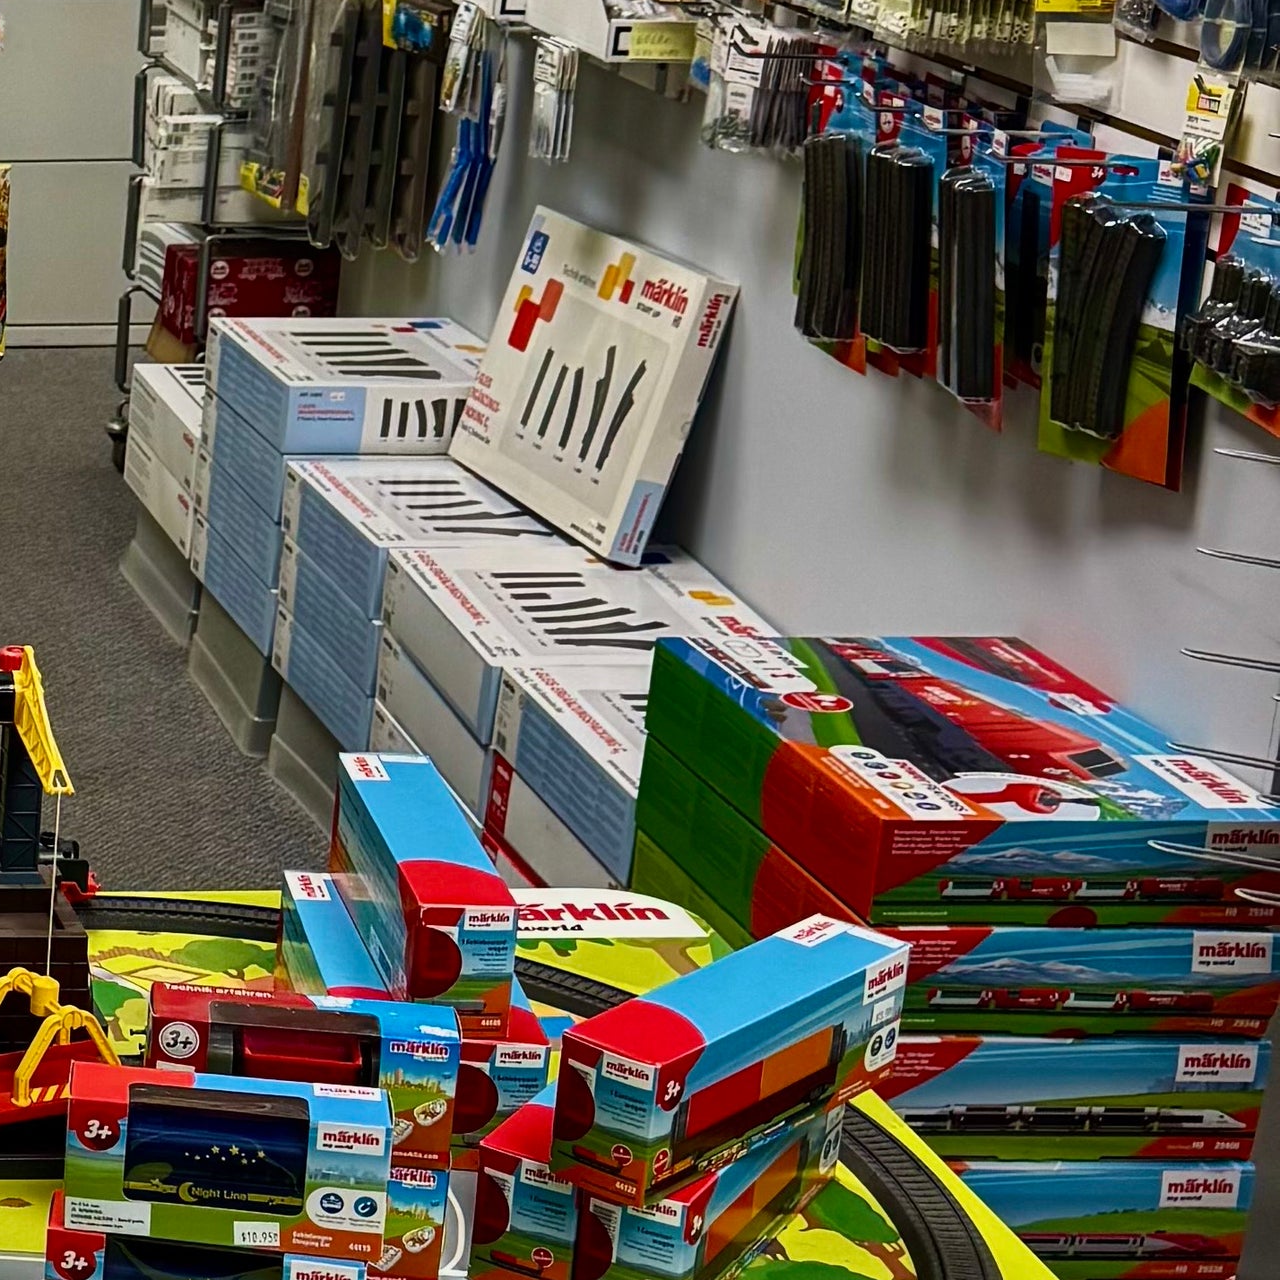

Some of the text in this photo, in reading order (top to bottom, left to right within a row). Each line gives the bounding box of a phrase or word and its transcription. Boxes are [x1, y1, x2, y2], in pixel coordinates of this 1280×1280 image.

[166, 1030, 192, 1049] 3+
[664, 1081, 680, 1101] 3+
[84, 1120, 112, 1140] 3+
[191, 1186, 247, 1201] Night Line
[61, 1251, 88, 1270] 3+
